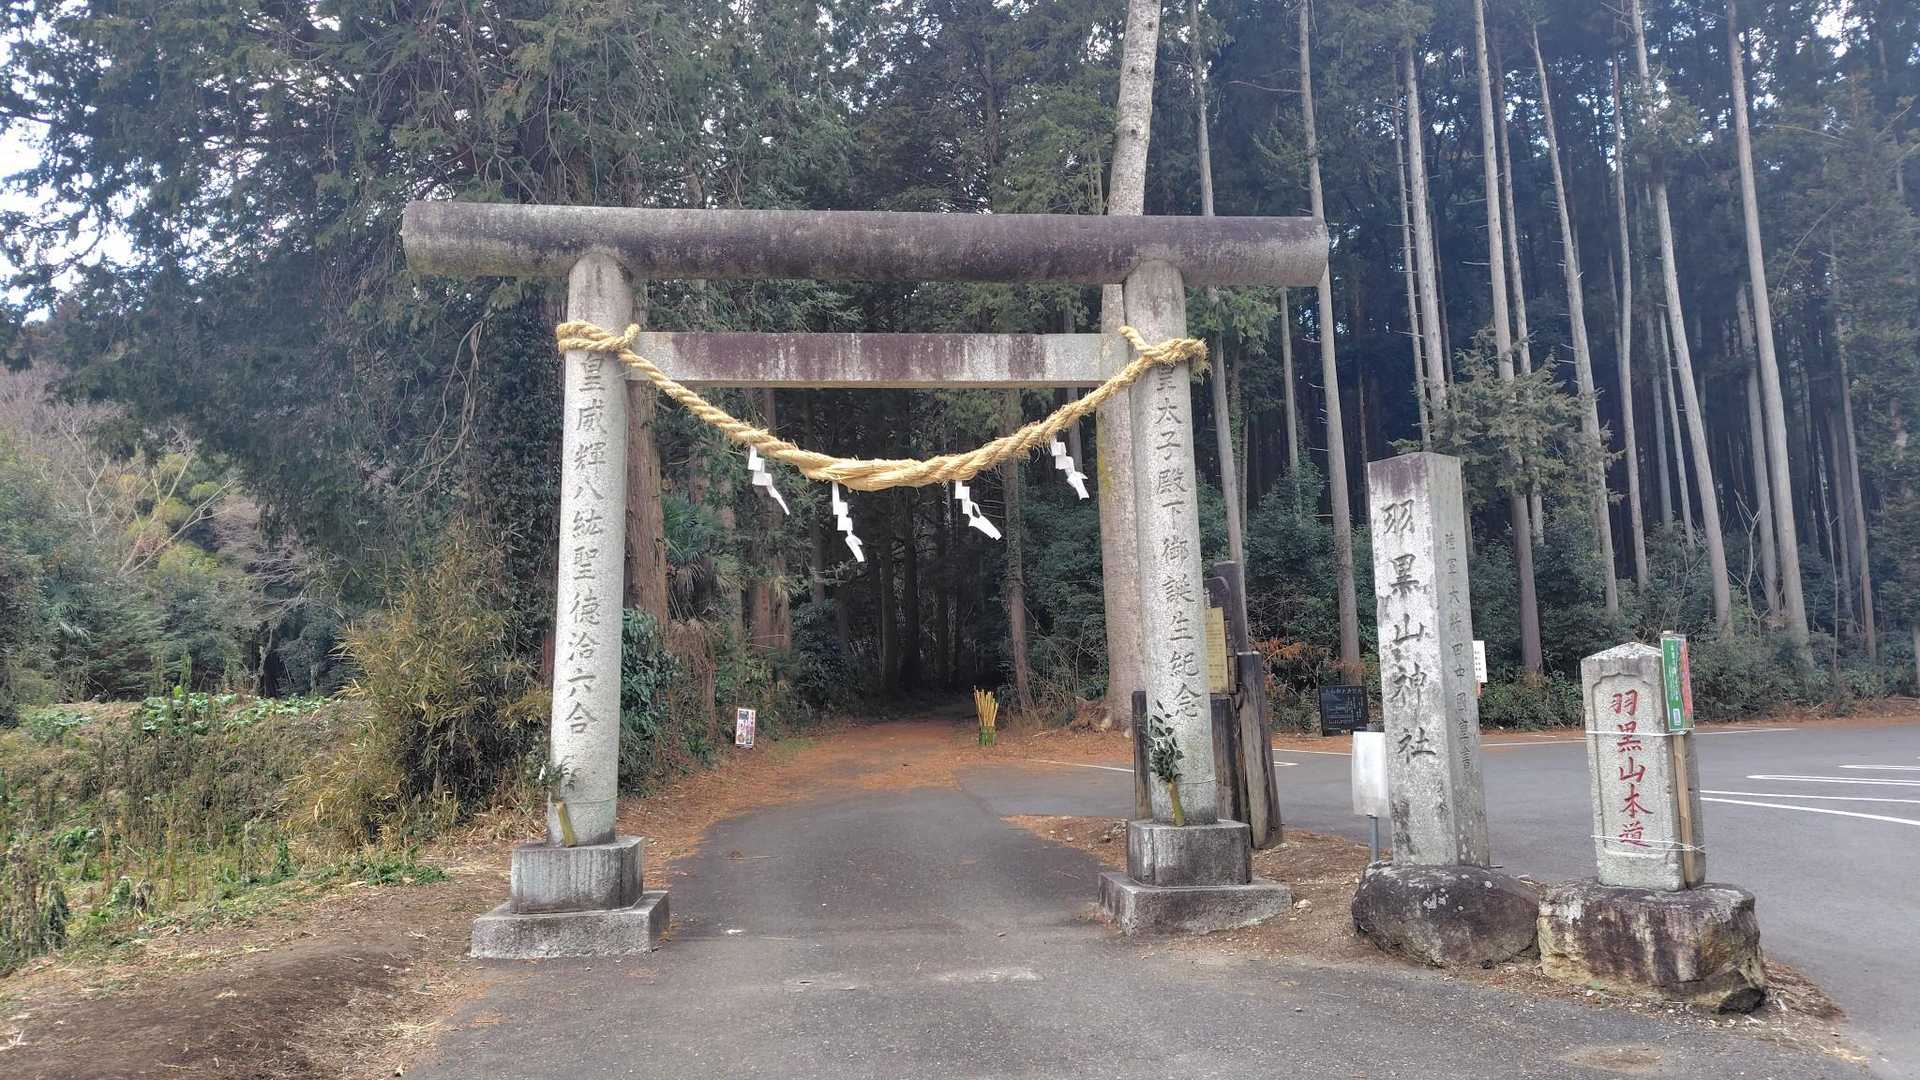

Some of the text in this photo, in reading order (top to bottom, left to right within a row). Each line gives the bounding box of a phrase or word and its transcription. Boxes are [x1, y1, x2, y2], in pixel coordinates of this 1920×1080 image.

[1380, 498, 1437, 764] 羽黒山神社
[1608, 688, 1654, 848] 羽黒山本道
